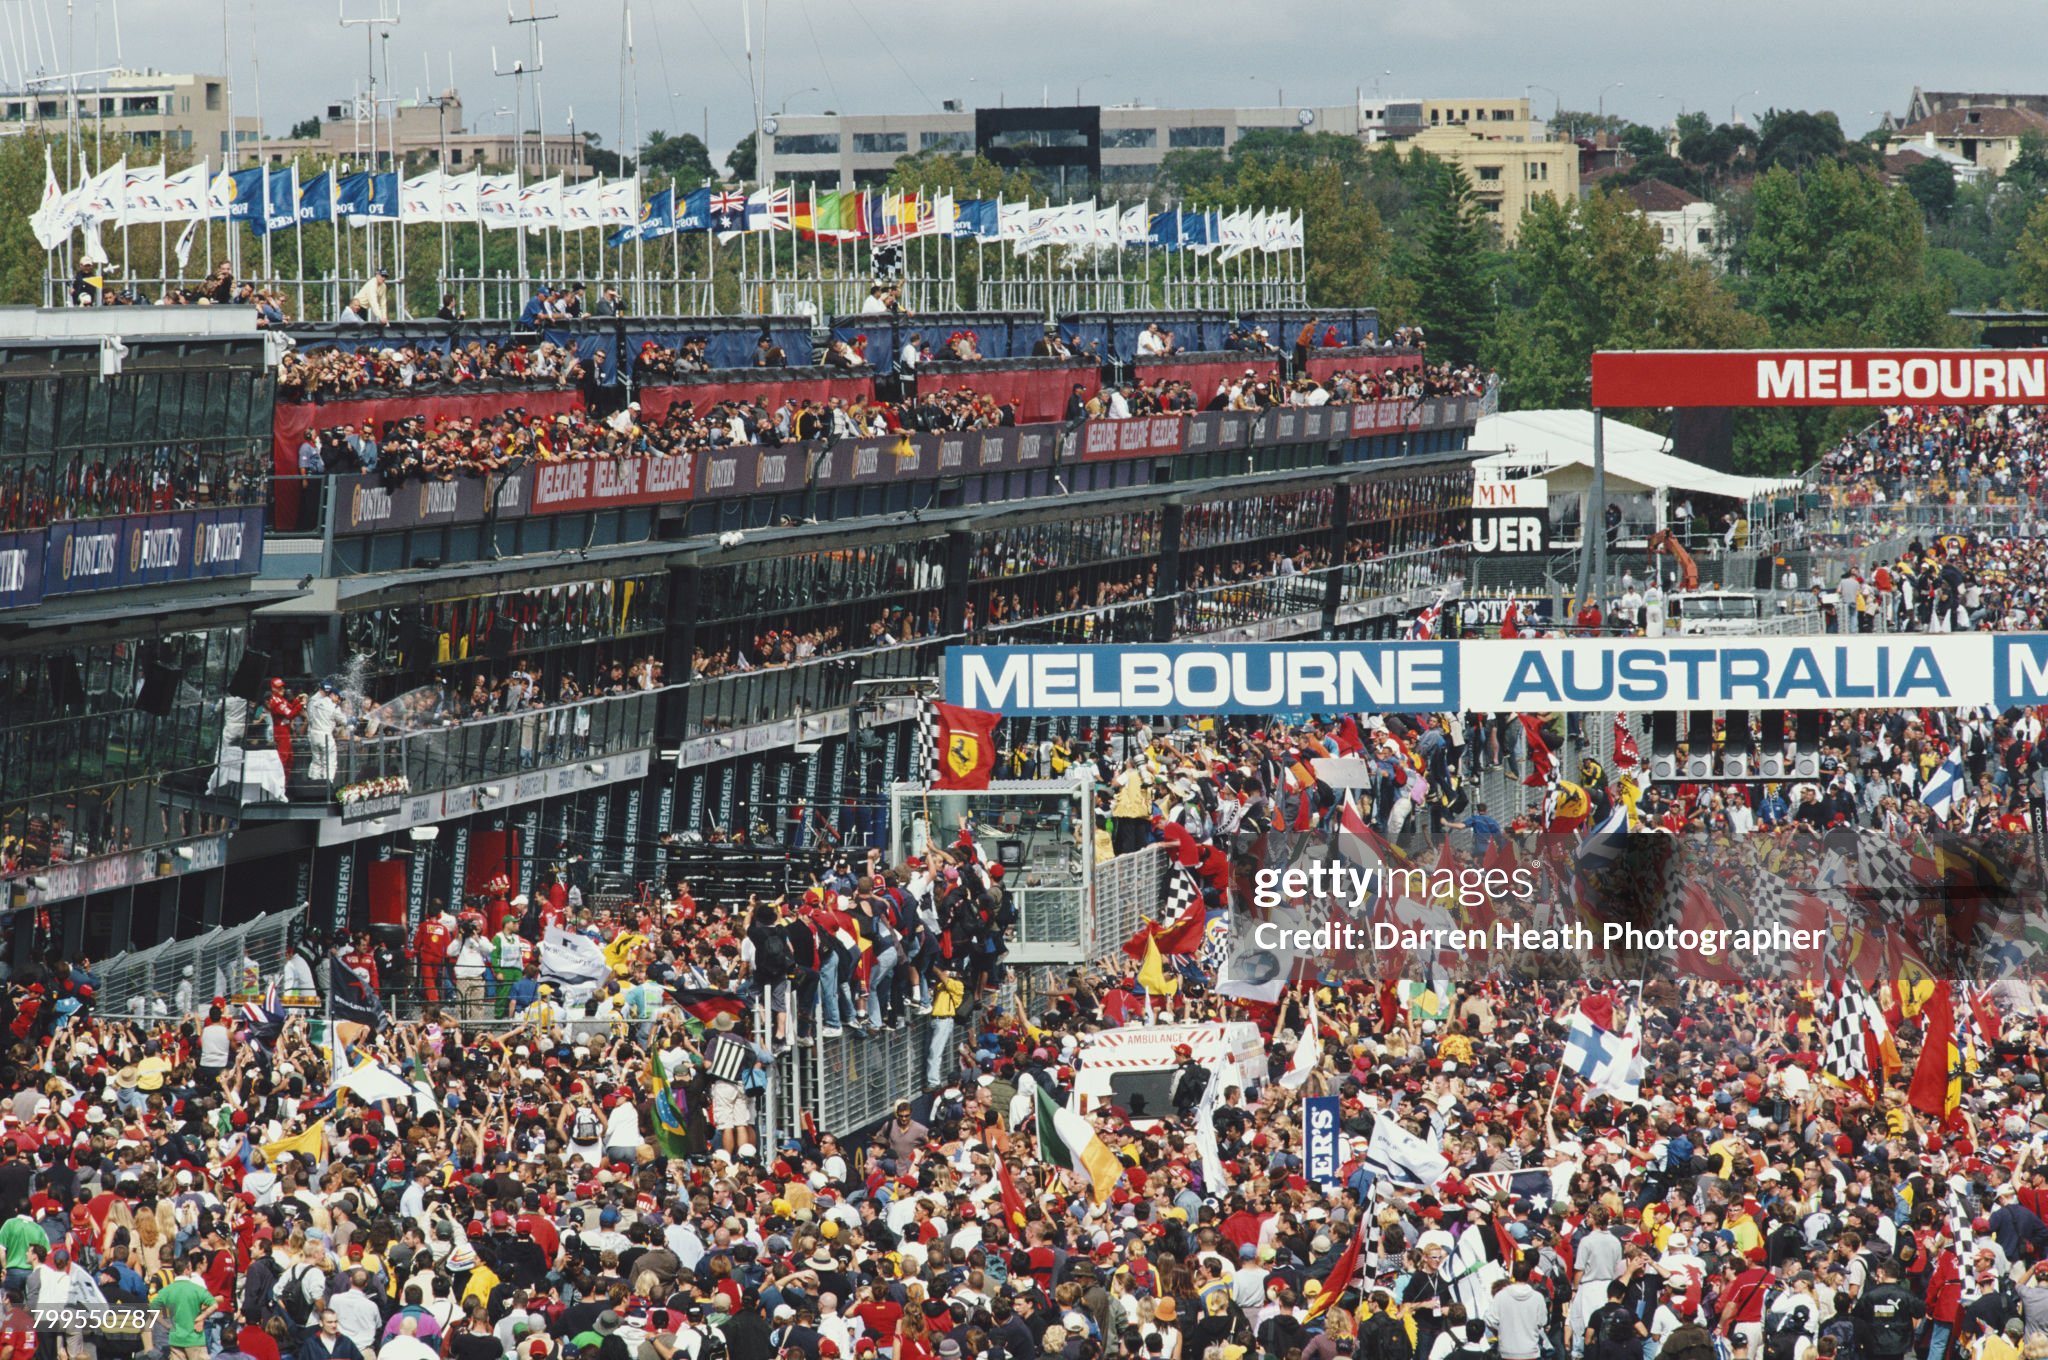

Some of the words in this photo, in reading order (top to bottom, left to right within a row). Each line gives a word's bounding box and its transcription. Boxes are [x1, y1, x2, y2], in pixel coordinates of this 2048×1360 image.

[1757, 359, 2045, 398] MELBOURN
[537, 461, 589, 504] MELBOURNE
[593, 457, 642, 497] MELBRNE
[645, 454, 693, 493] MELBOURNE
[810, 452, 834, 479] FTER'S
[359, 486, 392, 521] FOSTERS
[491, 475, 521, 508] FSTER'S
[1468, 517, 1542, 552] UER
[962, 649, 1444, 708] MELBOURNE
[1503, 648, 1951, 702] AUSTRALIA
[833, 743, 845, 792] SIEMENS
[885, 732, 897, 780] SIEMENS
[658, 787, 672, 833] SIEMEN
[689, 775, 703, 828] SIEMENS
[720, 767, 733, 820] SIEMENS
[749, 762, 762, 814] SEMENS
[522, 811, 537, 867] SEMENS
[626, 789, 640, 843] SIEMENS
[411, 853, 426, 895] SIEME
[453, 827, 468, 885] SIEMENS
[48, 866, 79, 901] IEMENS
[337, 855, 351, 916] SIEMENS
[1127, 1033, 1185, 1045] AMBULANCE
